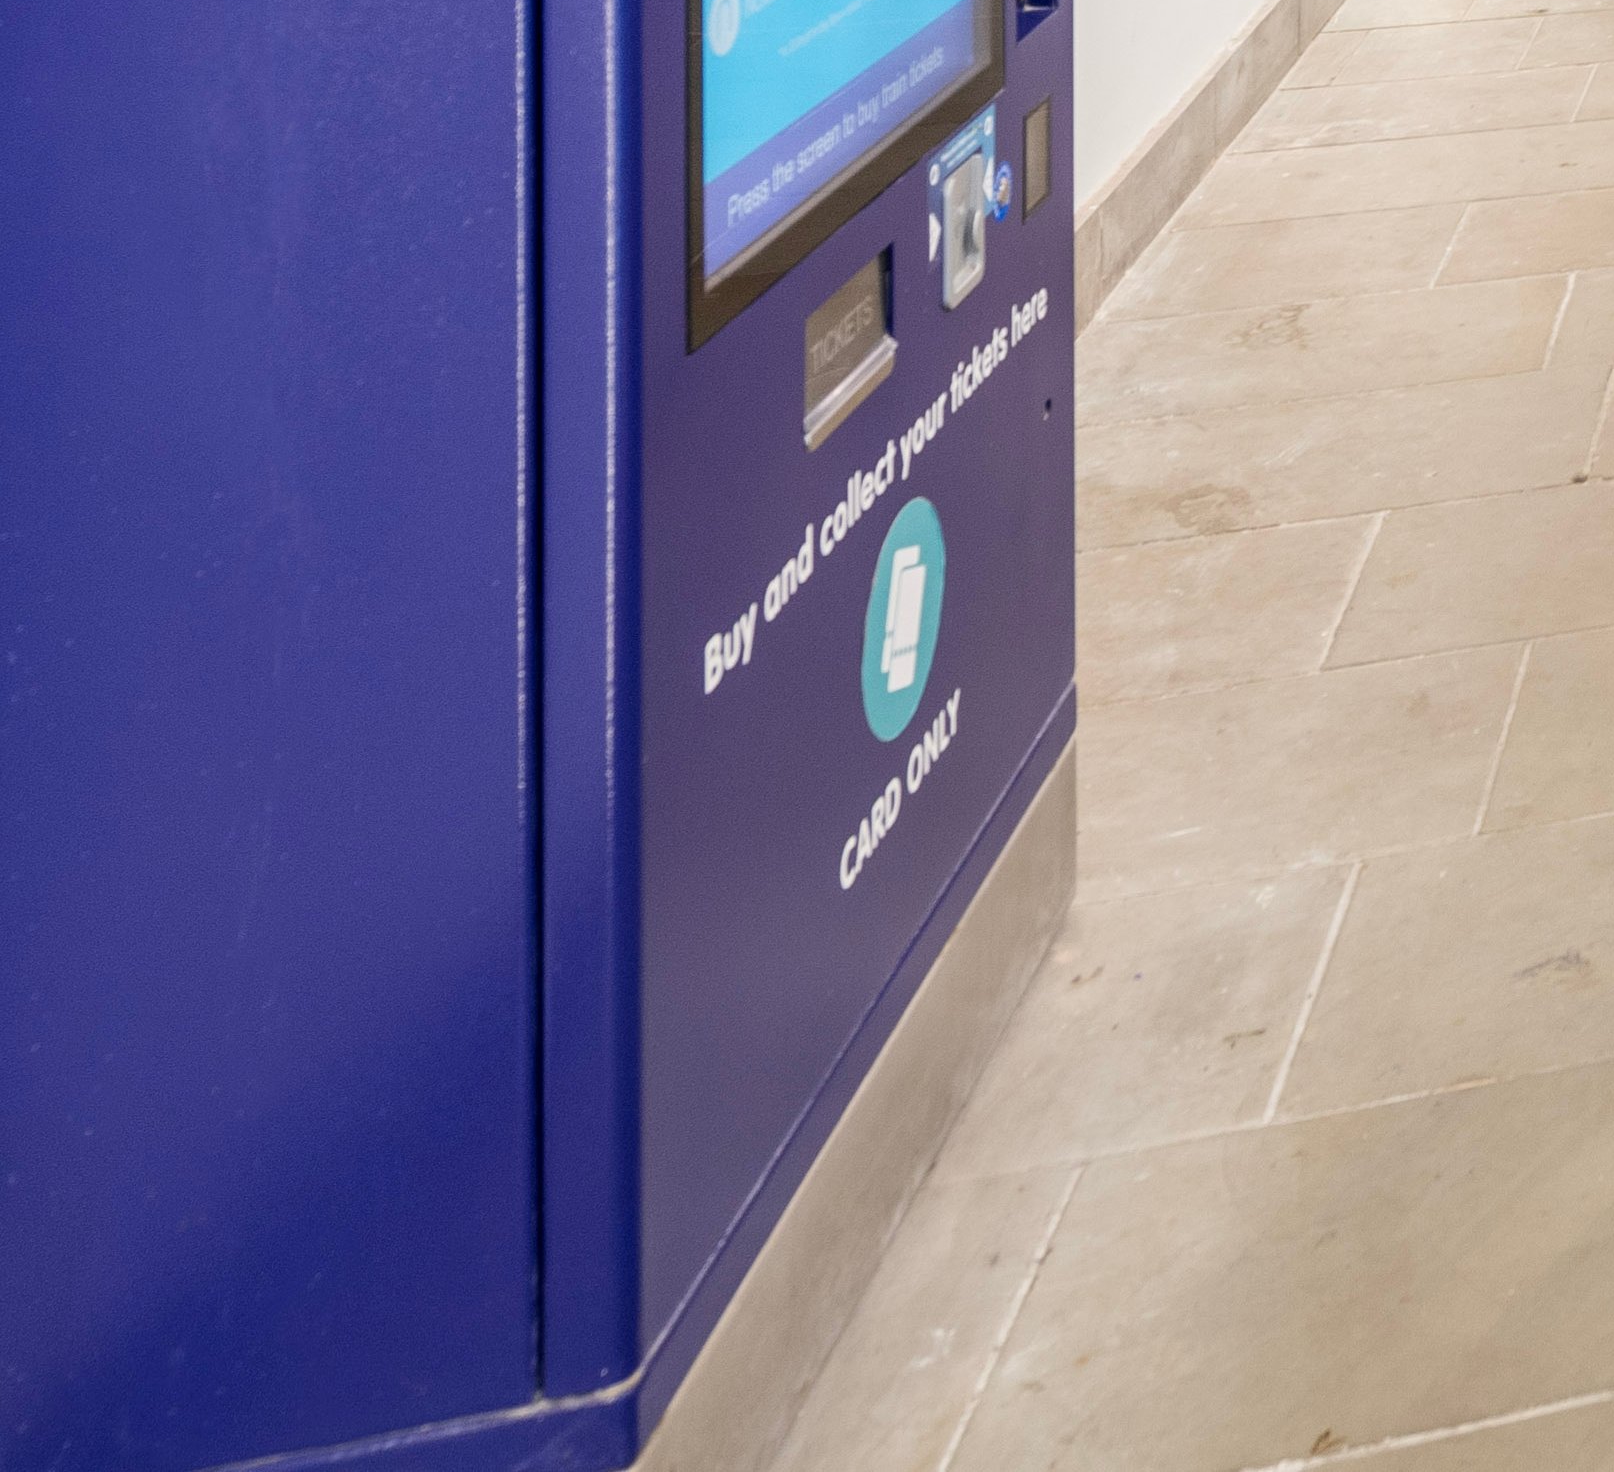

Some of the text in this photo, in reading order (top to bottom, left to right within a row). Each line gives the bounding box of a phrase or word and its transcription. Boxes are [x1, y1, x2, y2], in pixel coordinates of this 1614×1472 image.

[727, 46, 944, 227] Press the screen to buy train tickets
[809, 292, 876, 365] TICKETS
[704, 287, 1049, 694] Buy and collect your tickets here
[839, 688, 961, 890] CARD ONLY
